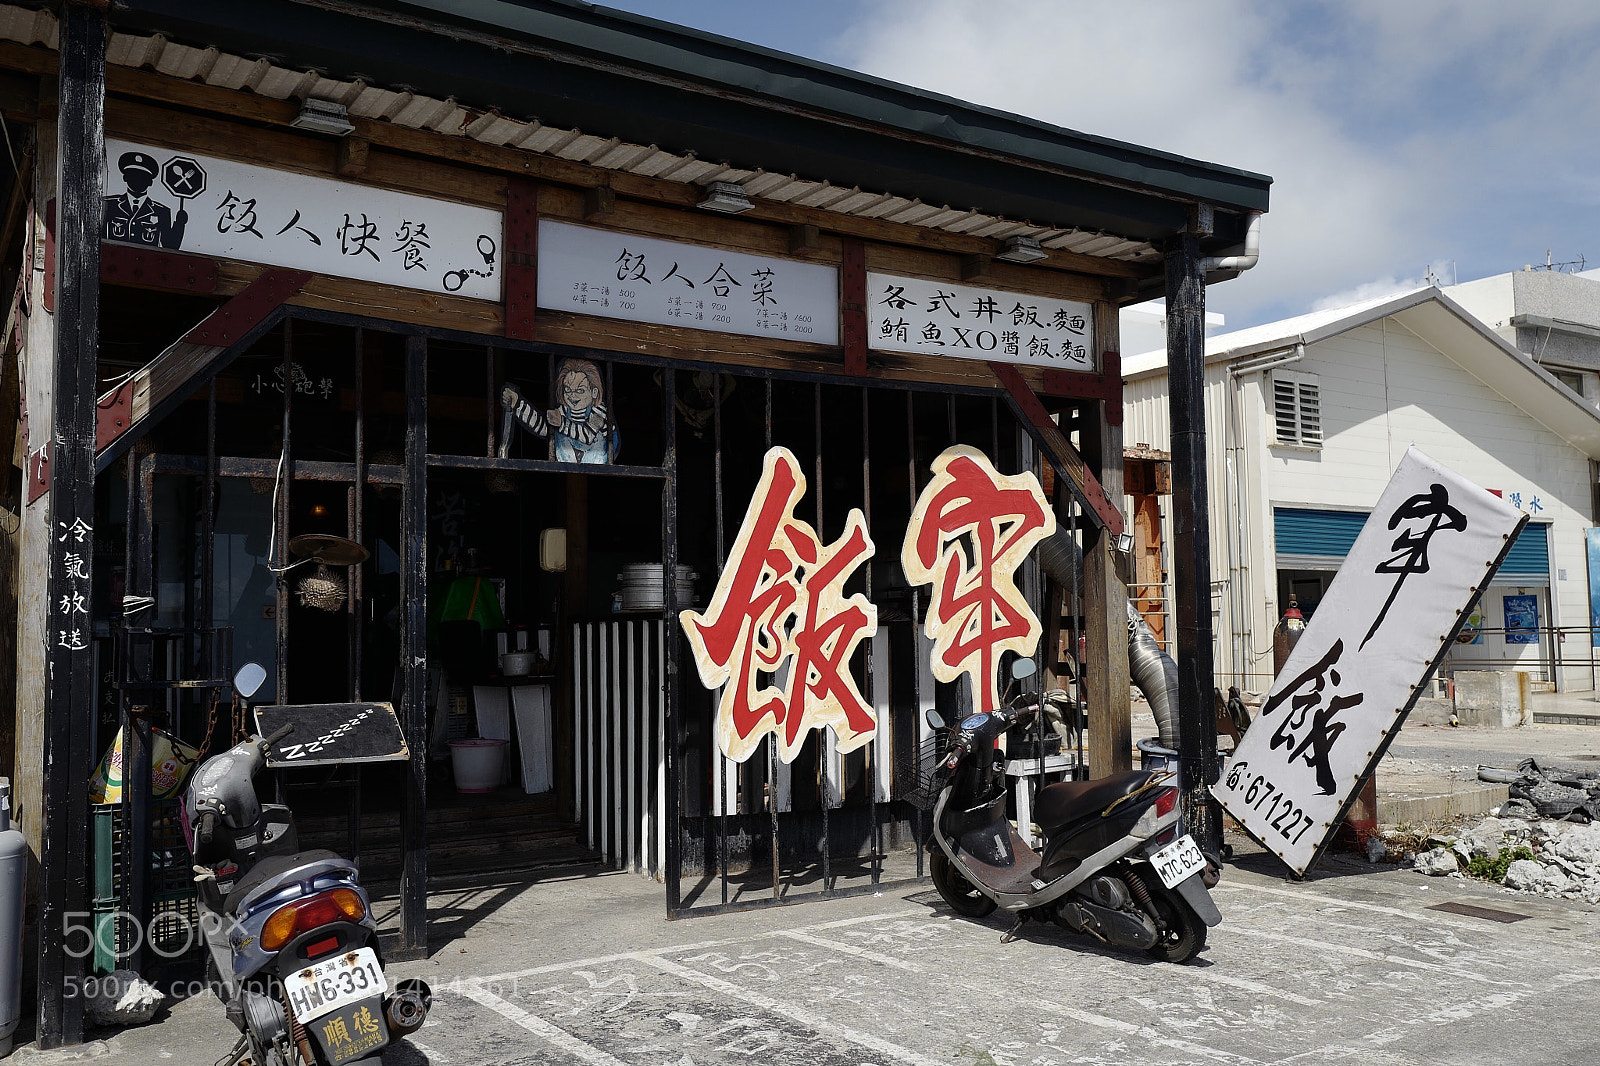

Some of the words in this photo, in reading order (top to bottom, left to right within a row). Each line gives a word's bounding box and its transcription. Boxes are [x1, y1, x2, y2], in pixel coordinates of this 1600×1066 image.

[215, 190, 432, 272] 飯人快餐
[614, 247, 778, 306] 飯人合菜
[618, 288, 636, 299] 500
[58, 516, 94, 651] 冷氣放送
[322, 1005, 379, 1048] 順德
